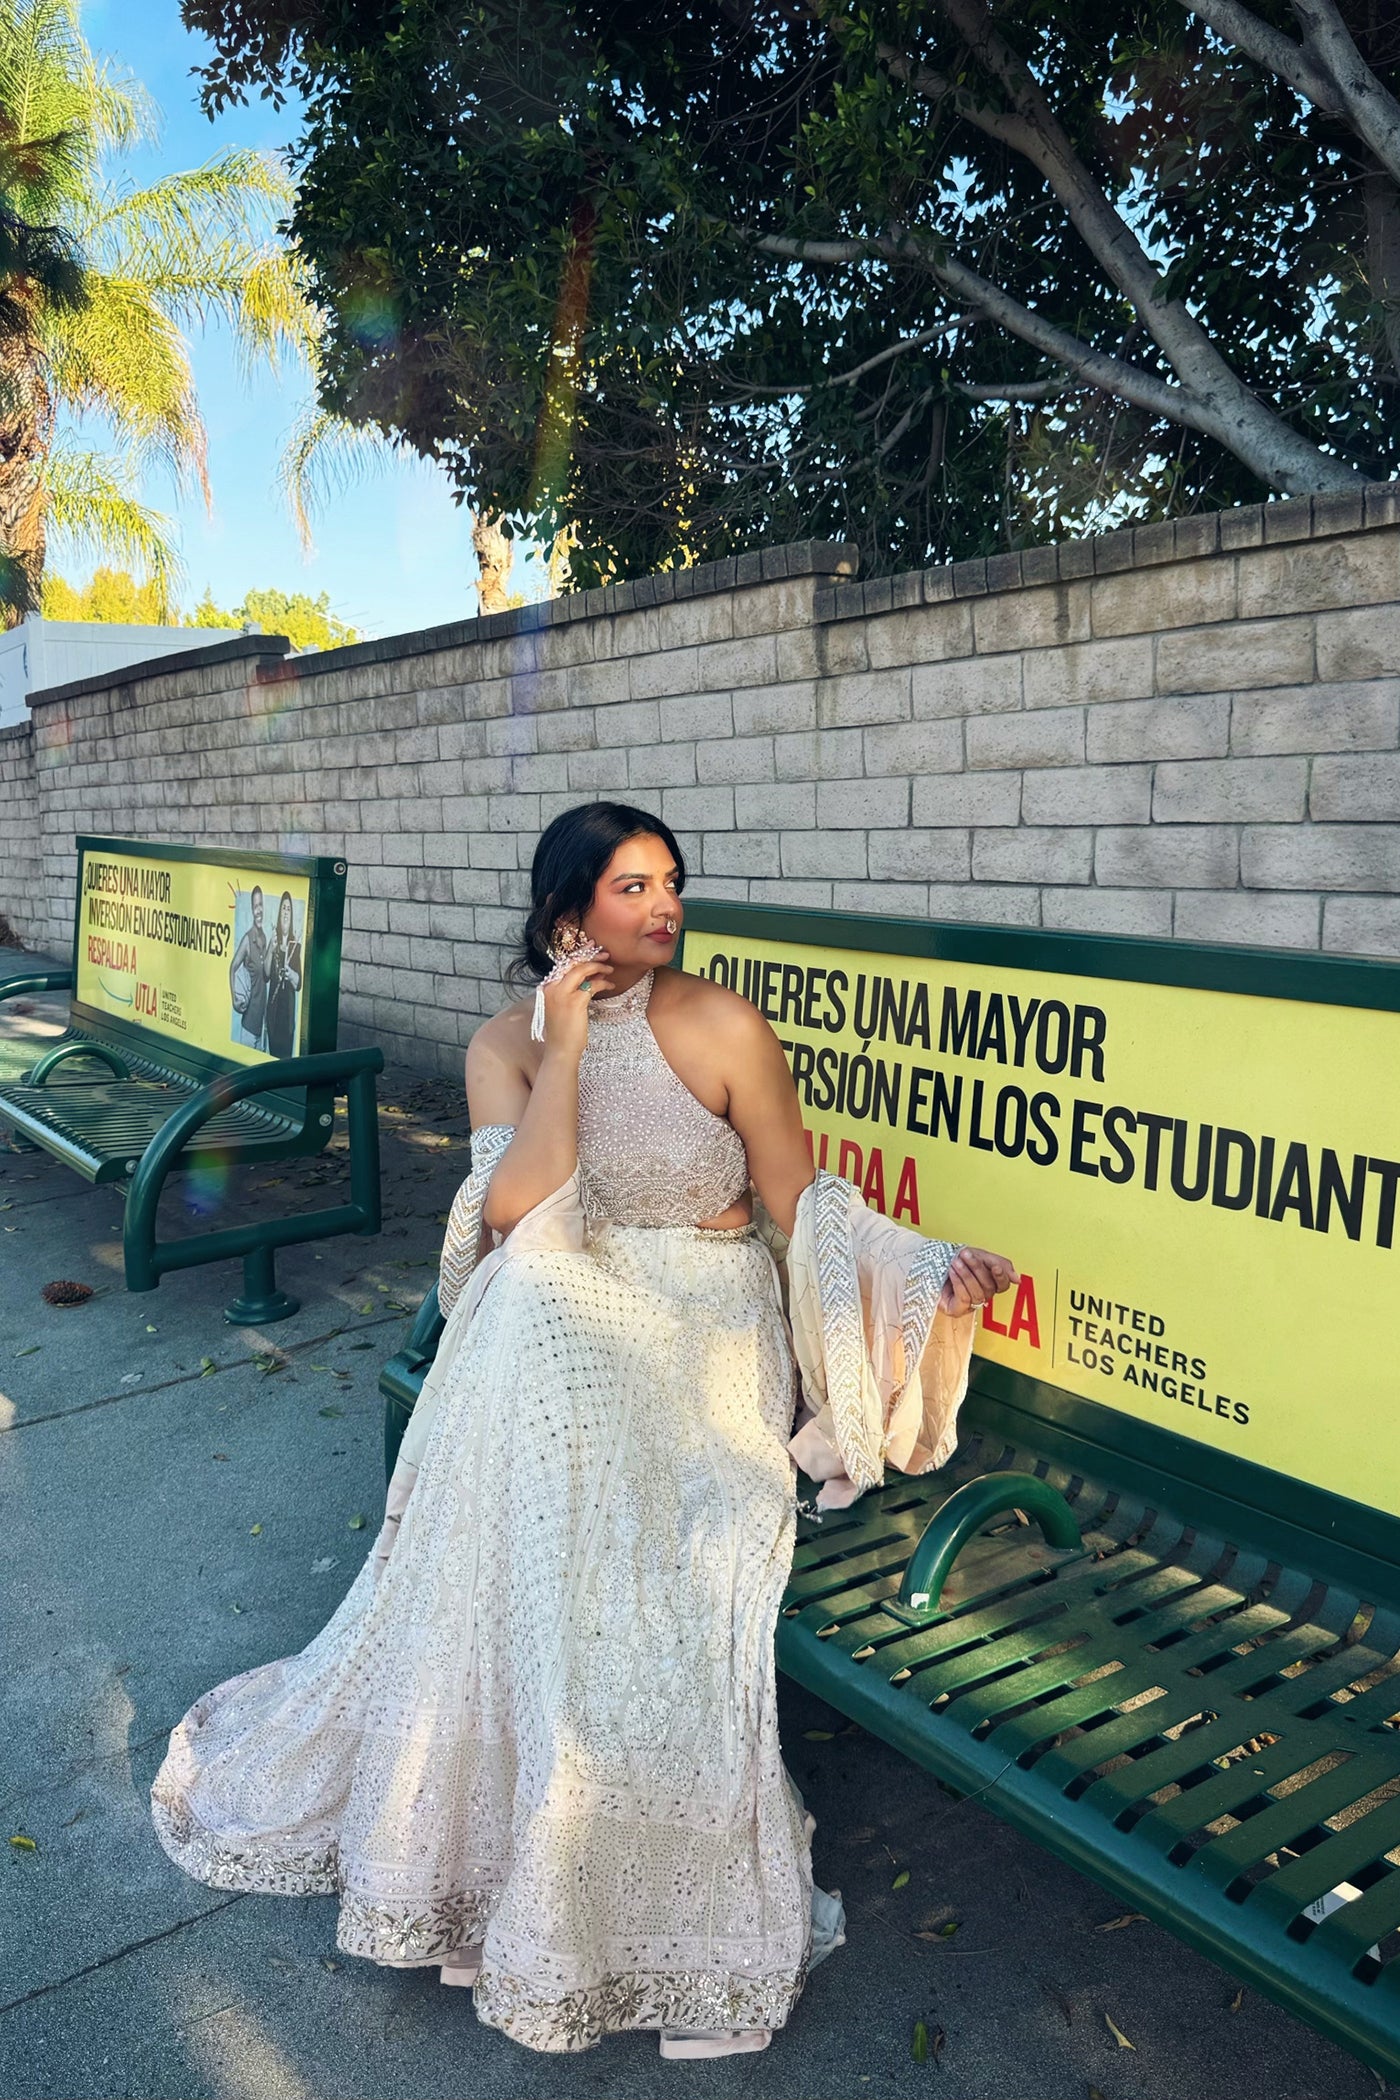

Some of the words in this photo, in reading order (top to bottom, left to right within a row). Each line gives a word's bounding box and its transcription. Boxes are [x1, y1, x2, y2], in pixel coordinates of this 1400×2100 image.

[120, 865, 139, 897] UNA
[140, 868, 171, 904] MAYOR
[88, 895, 133, 934] INVERSIÓN
[133, 905, 147, 936] EN
[147, 908, 163, 940] LOS
[164, 911, 231, 958] ESTUDIANTES?
[88, 935, 129, 973] RESPALDA
[130, 945, 137, 975] A
[135, 982, 158, 1018] UTLA
[853, 973, 932, 1052] UNA
[938, 986, 1107, 1083] MAYOR
[906, 1066, 964, 1144] EN
[968, 1079, 1060, 1167] LOS
[892, 1156, 921, 1226] A
[1069, 1288, 1166, 1339] UNITED
[1068, 1316, 1208, 1381] TEACHERS
[1066, 1342, 1116, 1376] LOS
[1122, 1364, 1251, 1426] ANGELES
